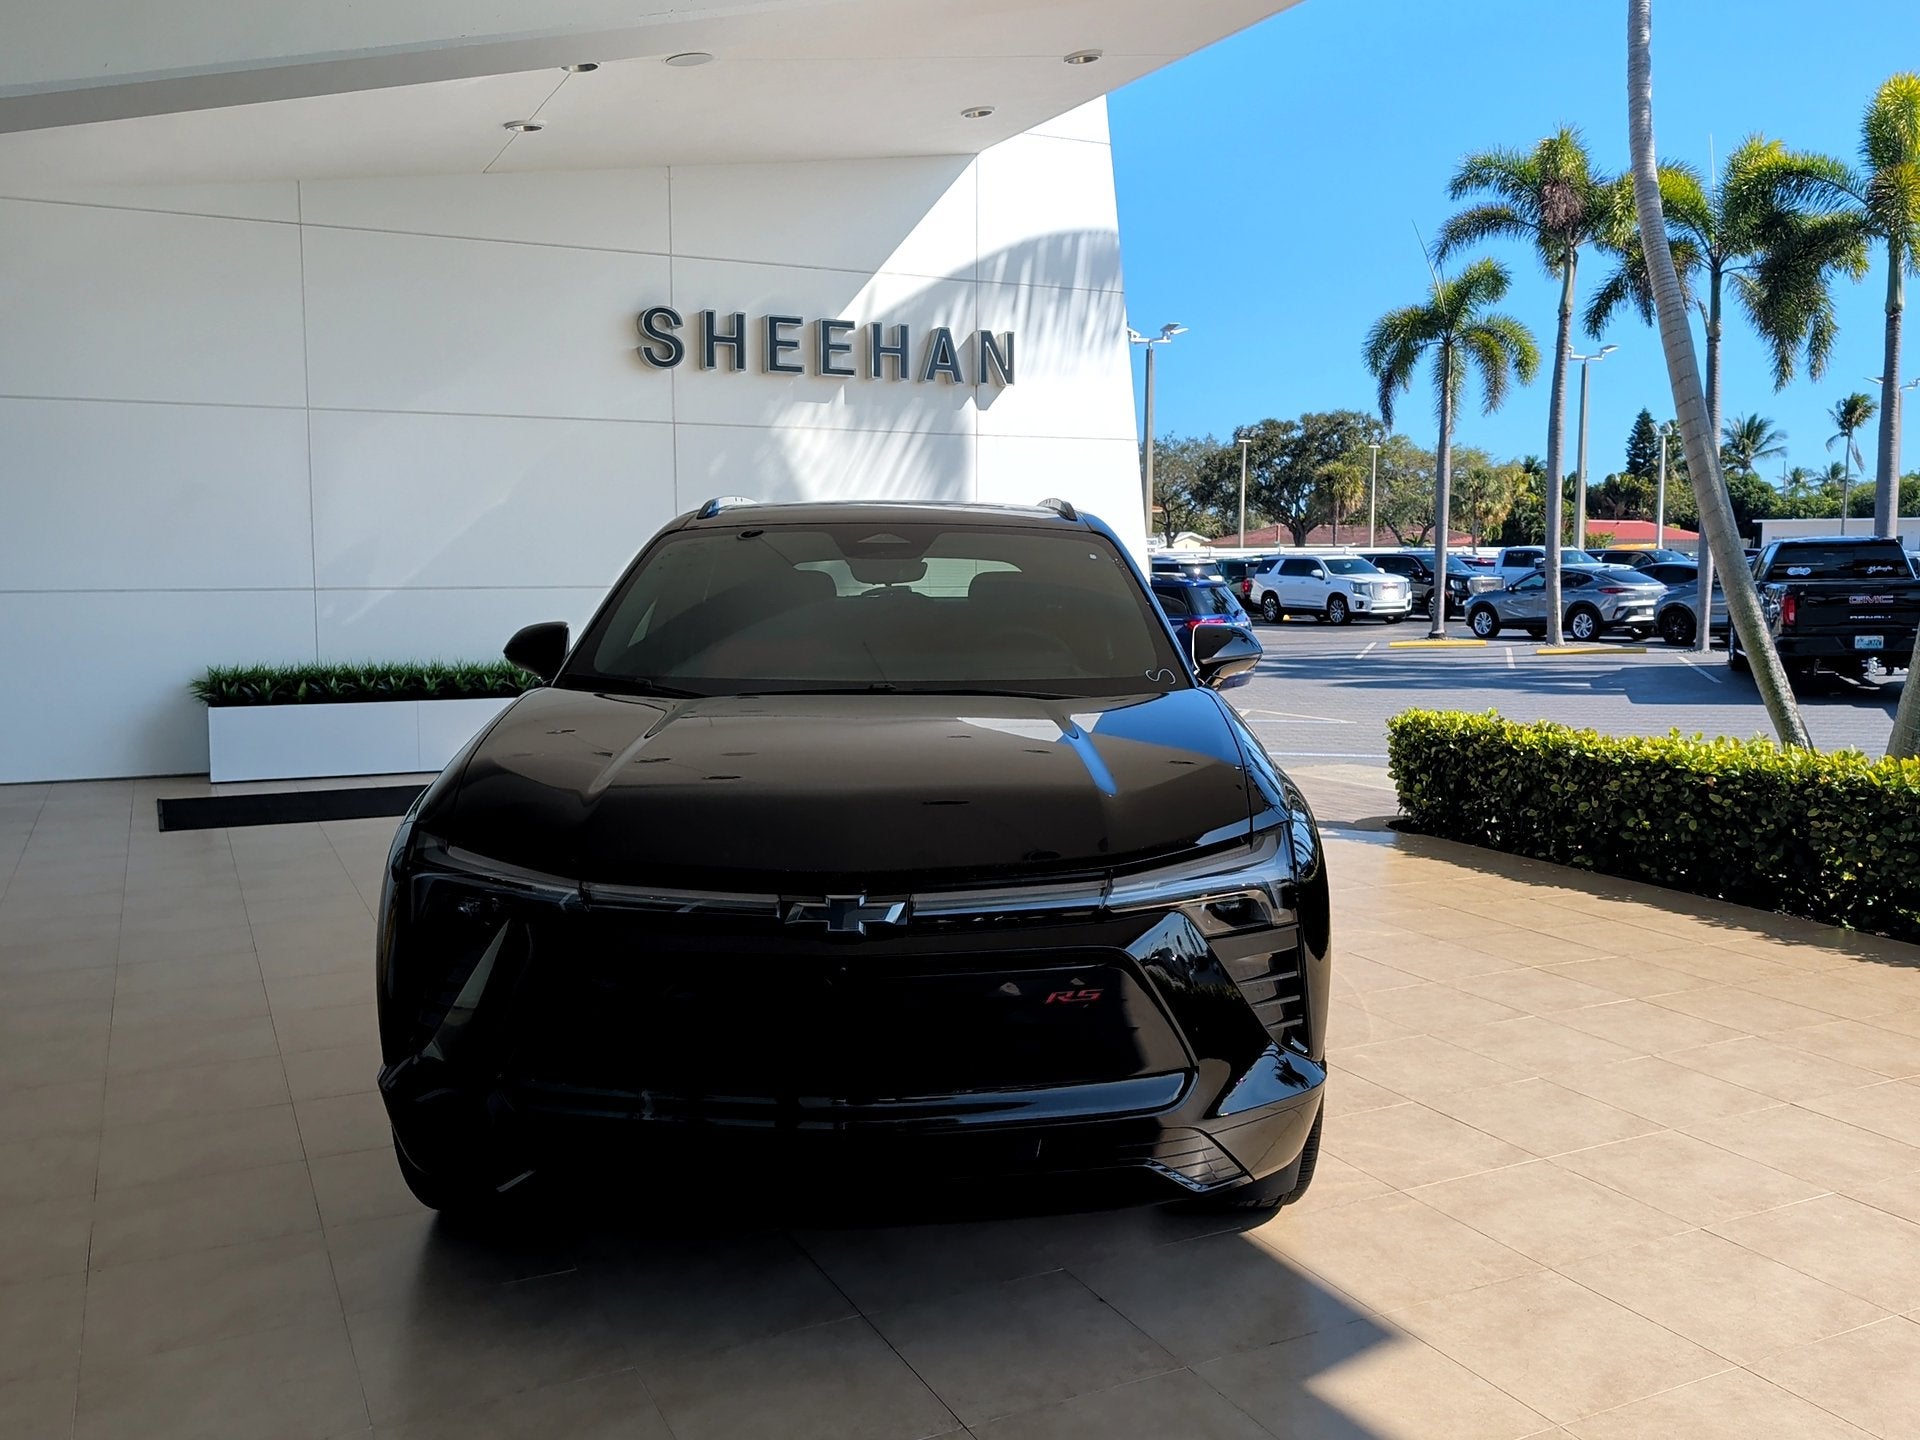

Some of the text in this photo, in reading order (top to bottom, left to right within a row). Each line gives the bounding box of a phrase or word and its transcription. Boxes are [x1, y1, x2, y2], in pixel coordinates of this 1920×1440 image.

[637, 305, 1016, 387] SHEEHAN
[1849, 595, 1894, 604] GMC
[1044, 988, 1104, 1005] RS
